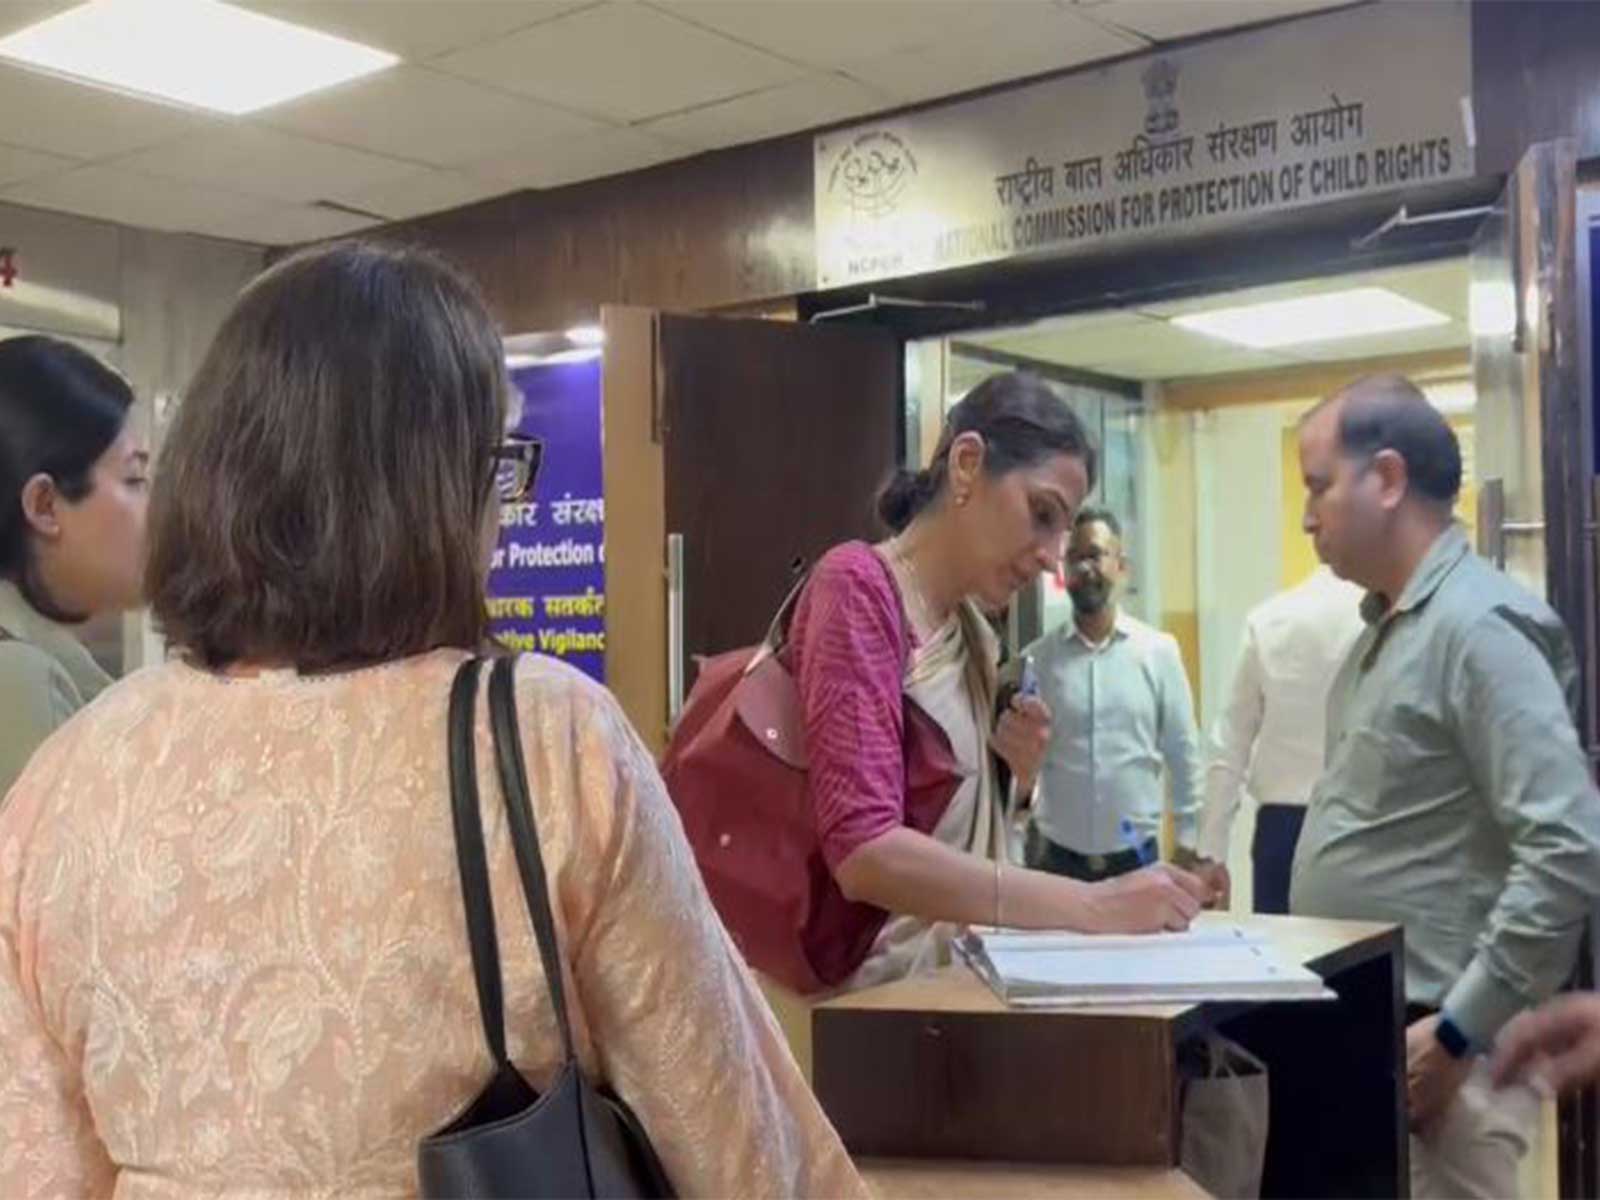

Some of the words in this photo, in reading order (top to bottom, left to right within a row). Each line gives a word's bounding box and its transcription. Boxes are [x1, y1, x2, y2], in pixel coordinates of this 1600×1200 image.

[995, 157, 1054, 206] राष्ट्रीय
[1064, 157, 1102, 192] बाल
[1115, 133, 1194, 181] अधिकार
[1206, 122, 1278, 162] संरक्षण
[1291, 94, 1363, 147] आयोग
[1014, 198, 1116, 246] COMMISSION
[1121, 188, 1155, 229] FOR
[1160, 168, 1274, 223] PROTECTION
[1280, 161, 1304, 200] OF
[1310, 152, 1369, 196] CHILD
[1375, 137, 1451, 185] RIGHTS
[549, 492, 605, 525] संरक्ष
[509, 540, 594, 567] Protection
[538, 627, 605, 655] Vigilanc
